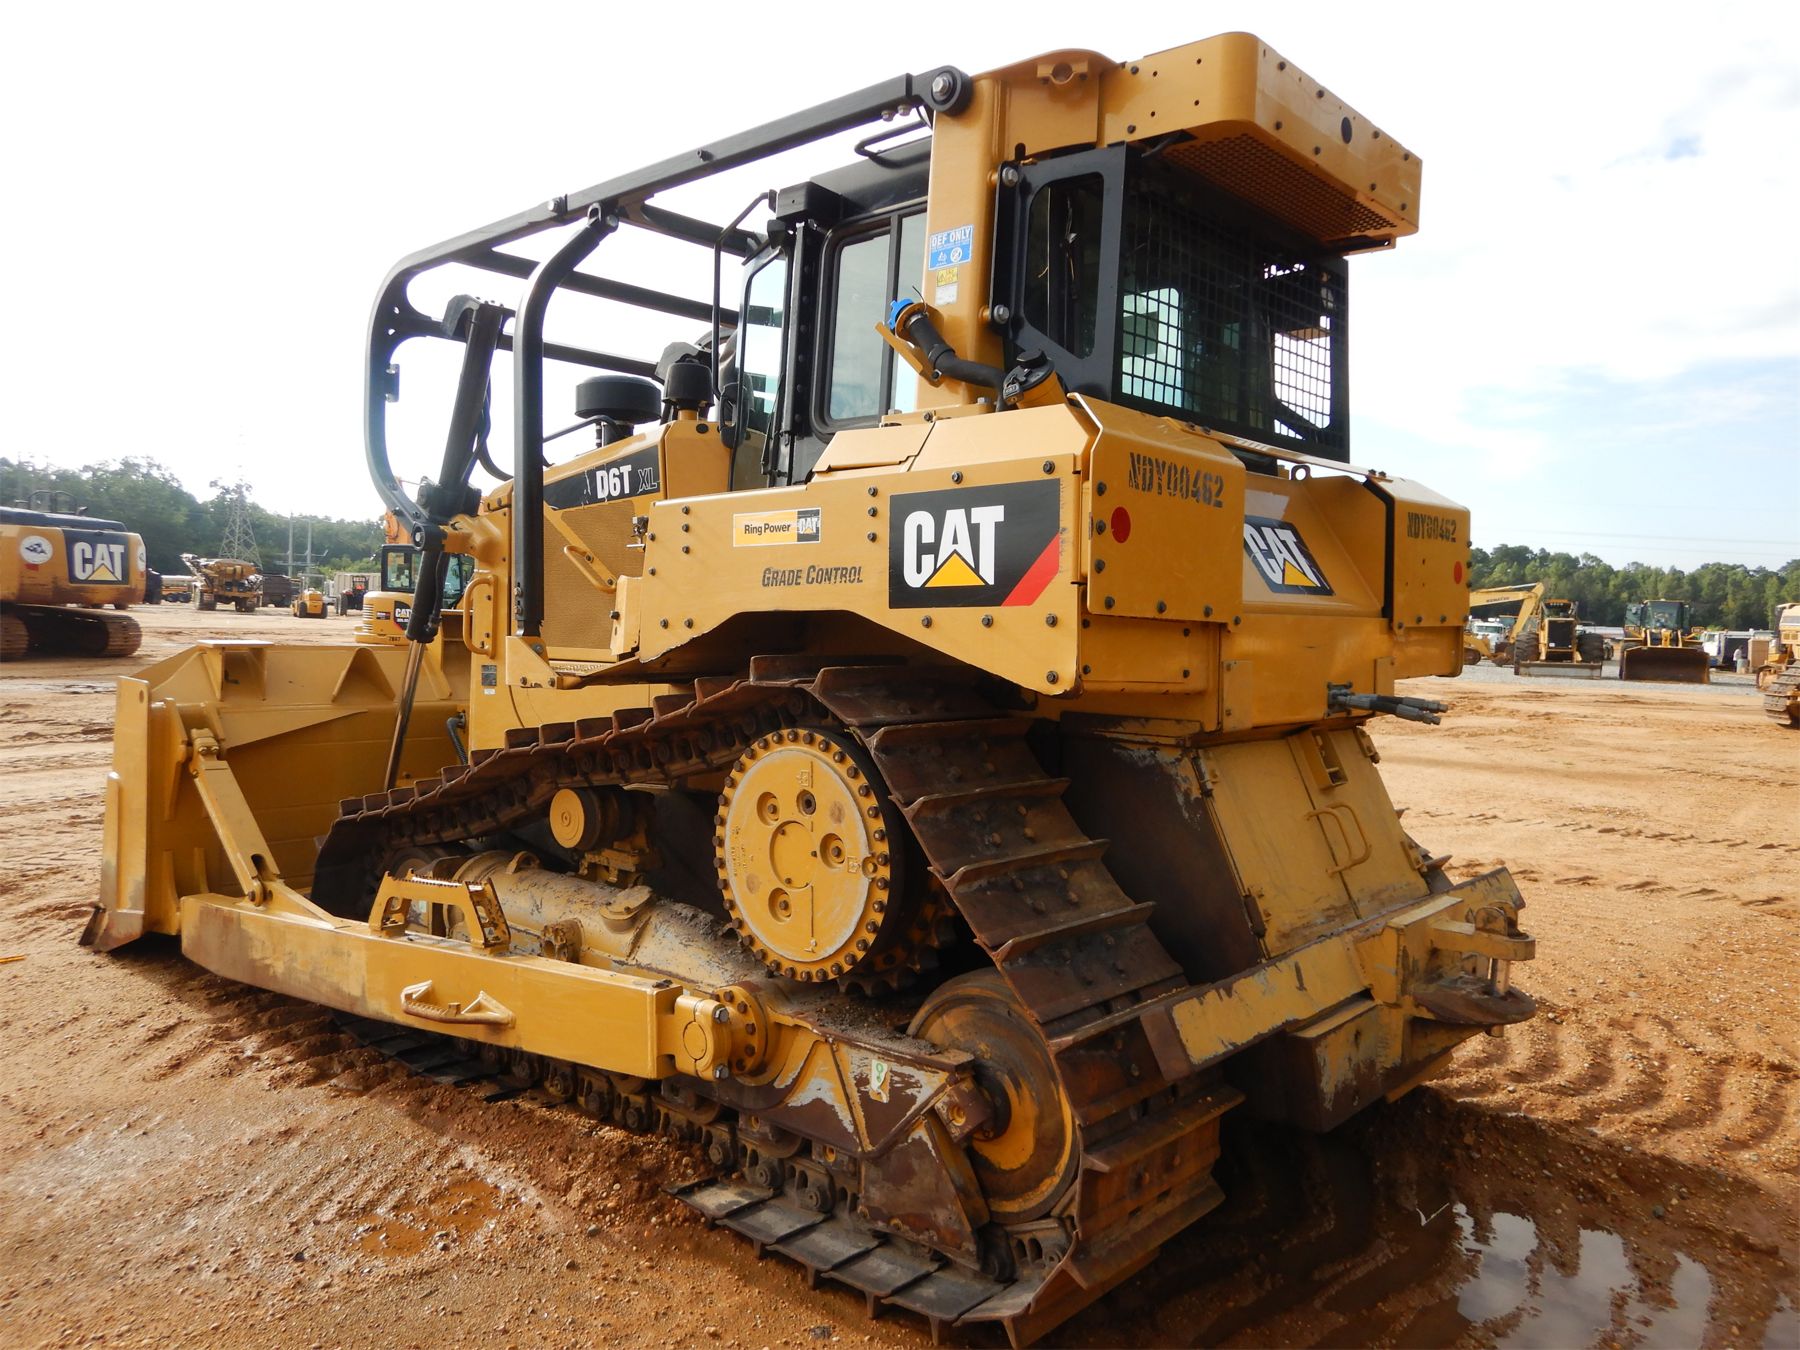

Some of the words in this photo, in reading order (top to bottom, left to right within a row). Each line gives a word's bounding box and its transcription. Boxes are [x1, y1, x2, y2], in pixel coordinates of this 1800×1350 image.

[931, 232, 950, 247] DEF
[950, 226, 972, 243] ONLY
[596, 464, 632, 499] D6T
[637, 467, 657, 491] XL
[744, 524, 763, 535] Ring
[763, 523, 791, 534] Power
[798, 517, 819, 534] CAT
[903, 505, 1005, 588] CAT
[1243, 523, 1321, 587] CAT
[73, 541, 125, 581] CAT
[762, 567, 802, 587] GRADE
[805, 564, 863, 585] CONTROL
[395, 608, 412, 618] CAT
